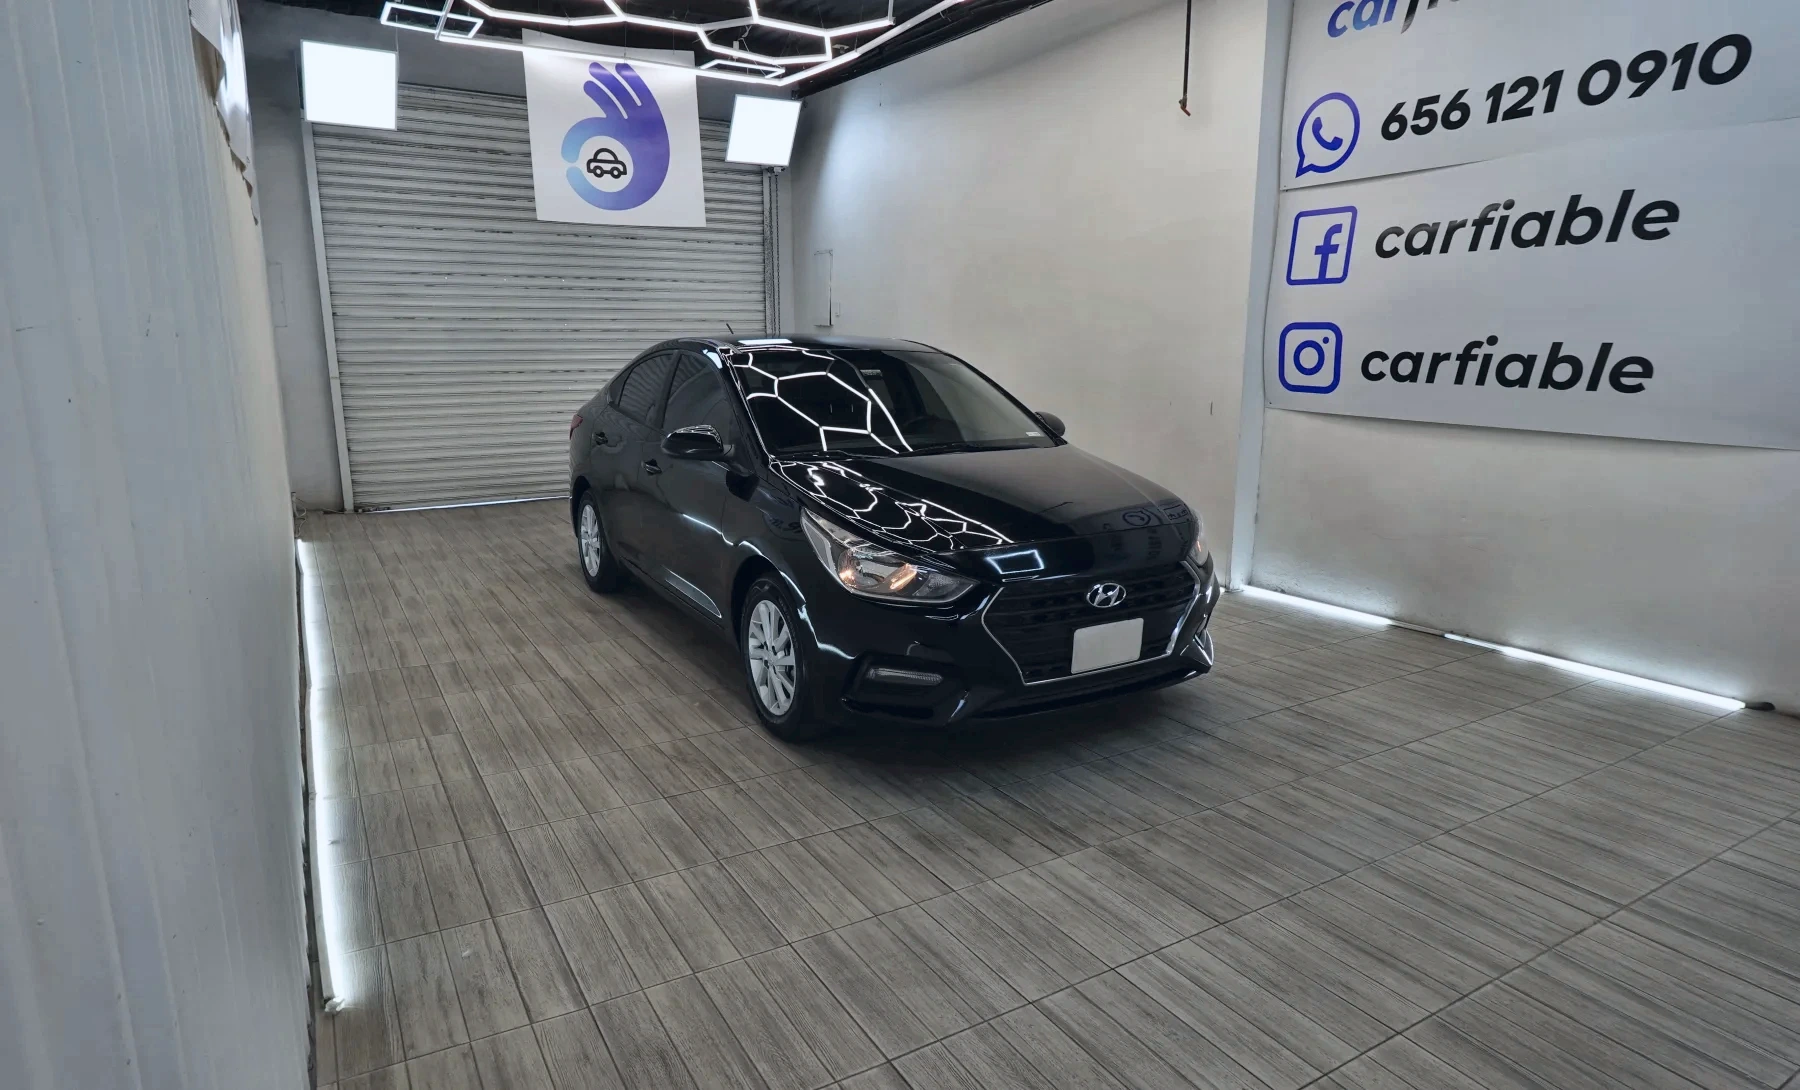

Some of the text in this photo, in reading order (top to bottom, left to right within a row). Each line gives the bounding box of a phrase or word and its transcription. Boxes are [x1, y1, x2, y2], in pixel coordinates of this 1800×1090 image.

[1327, 0, 1460, 38] car
[1380, 33, 1753, 141] 656 121 0910
[1375, 188, 1681, 259] carfiable
[1360, 335, 1655, 394] carfiable
